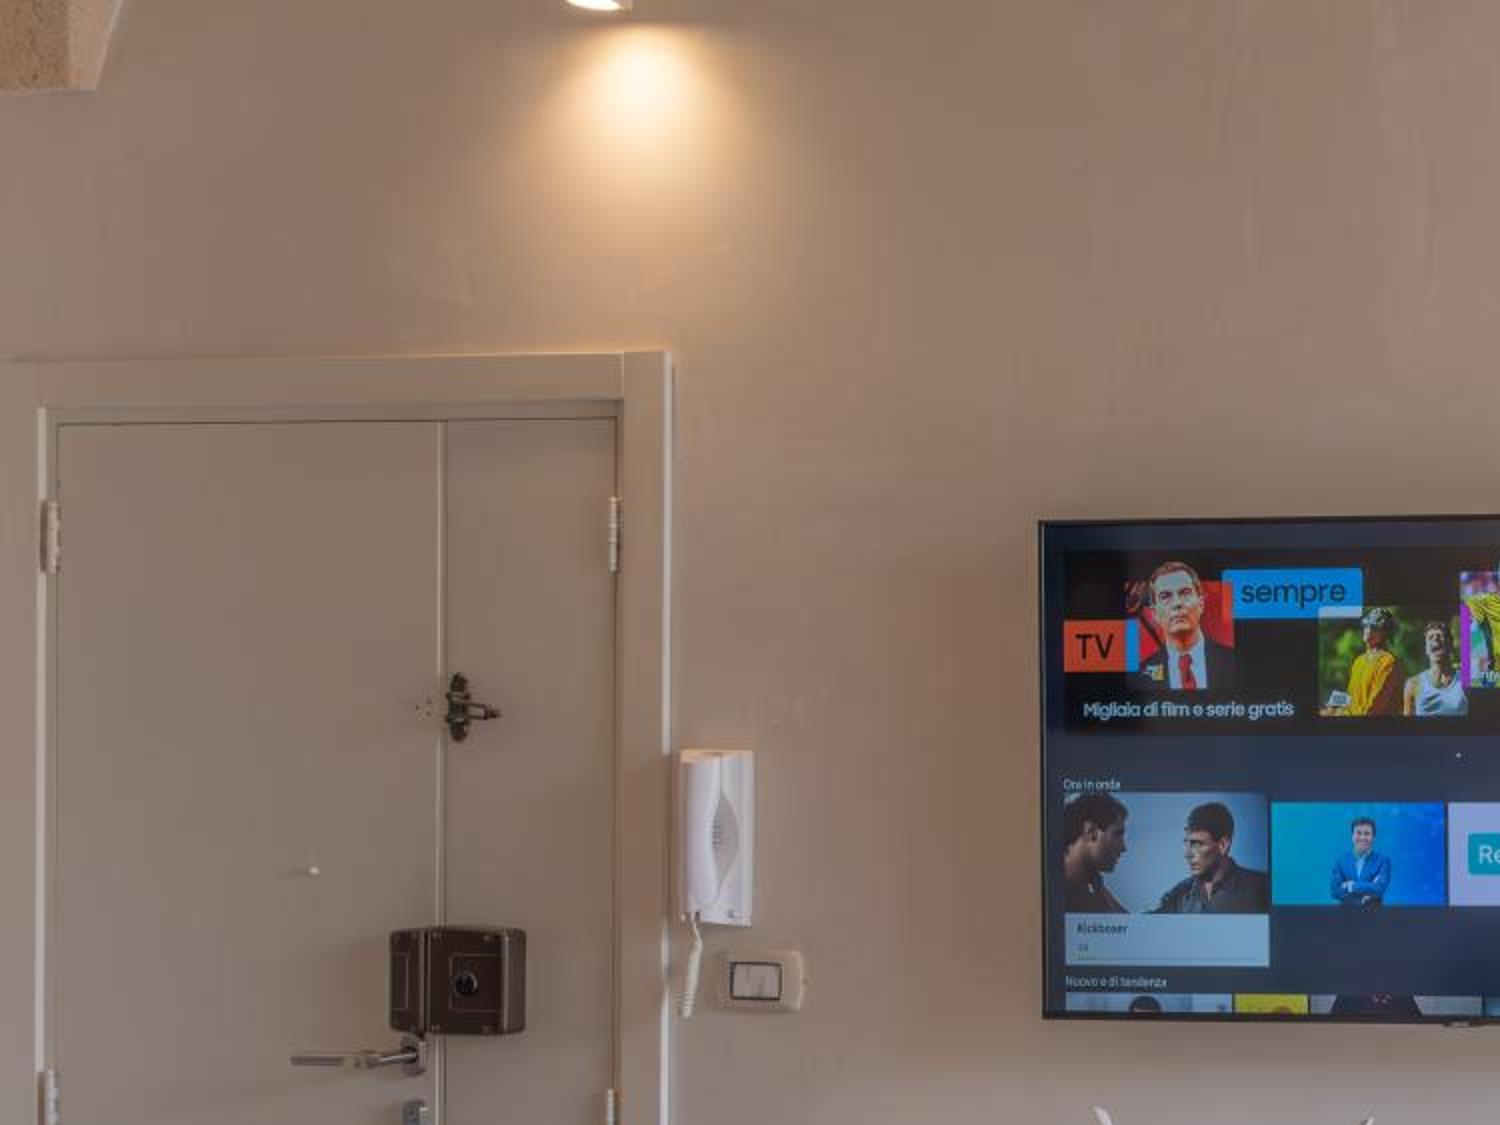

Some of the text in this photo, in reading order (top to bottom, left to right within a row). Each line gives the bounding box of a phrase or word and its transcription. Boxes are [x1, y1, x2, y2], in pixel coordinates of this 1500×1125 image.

[1241, 581, 1346, 608] sempre
[1076, 634, 1115, 660] TV
[1083, 701, 1295, 720] Migliaia di film e serie gratis
